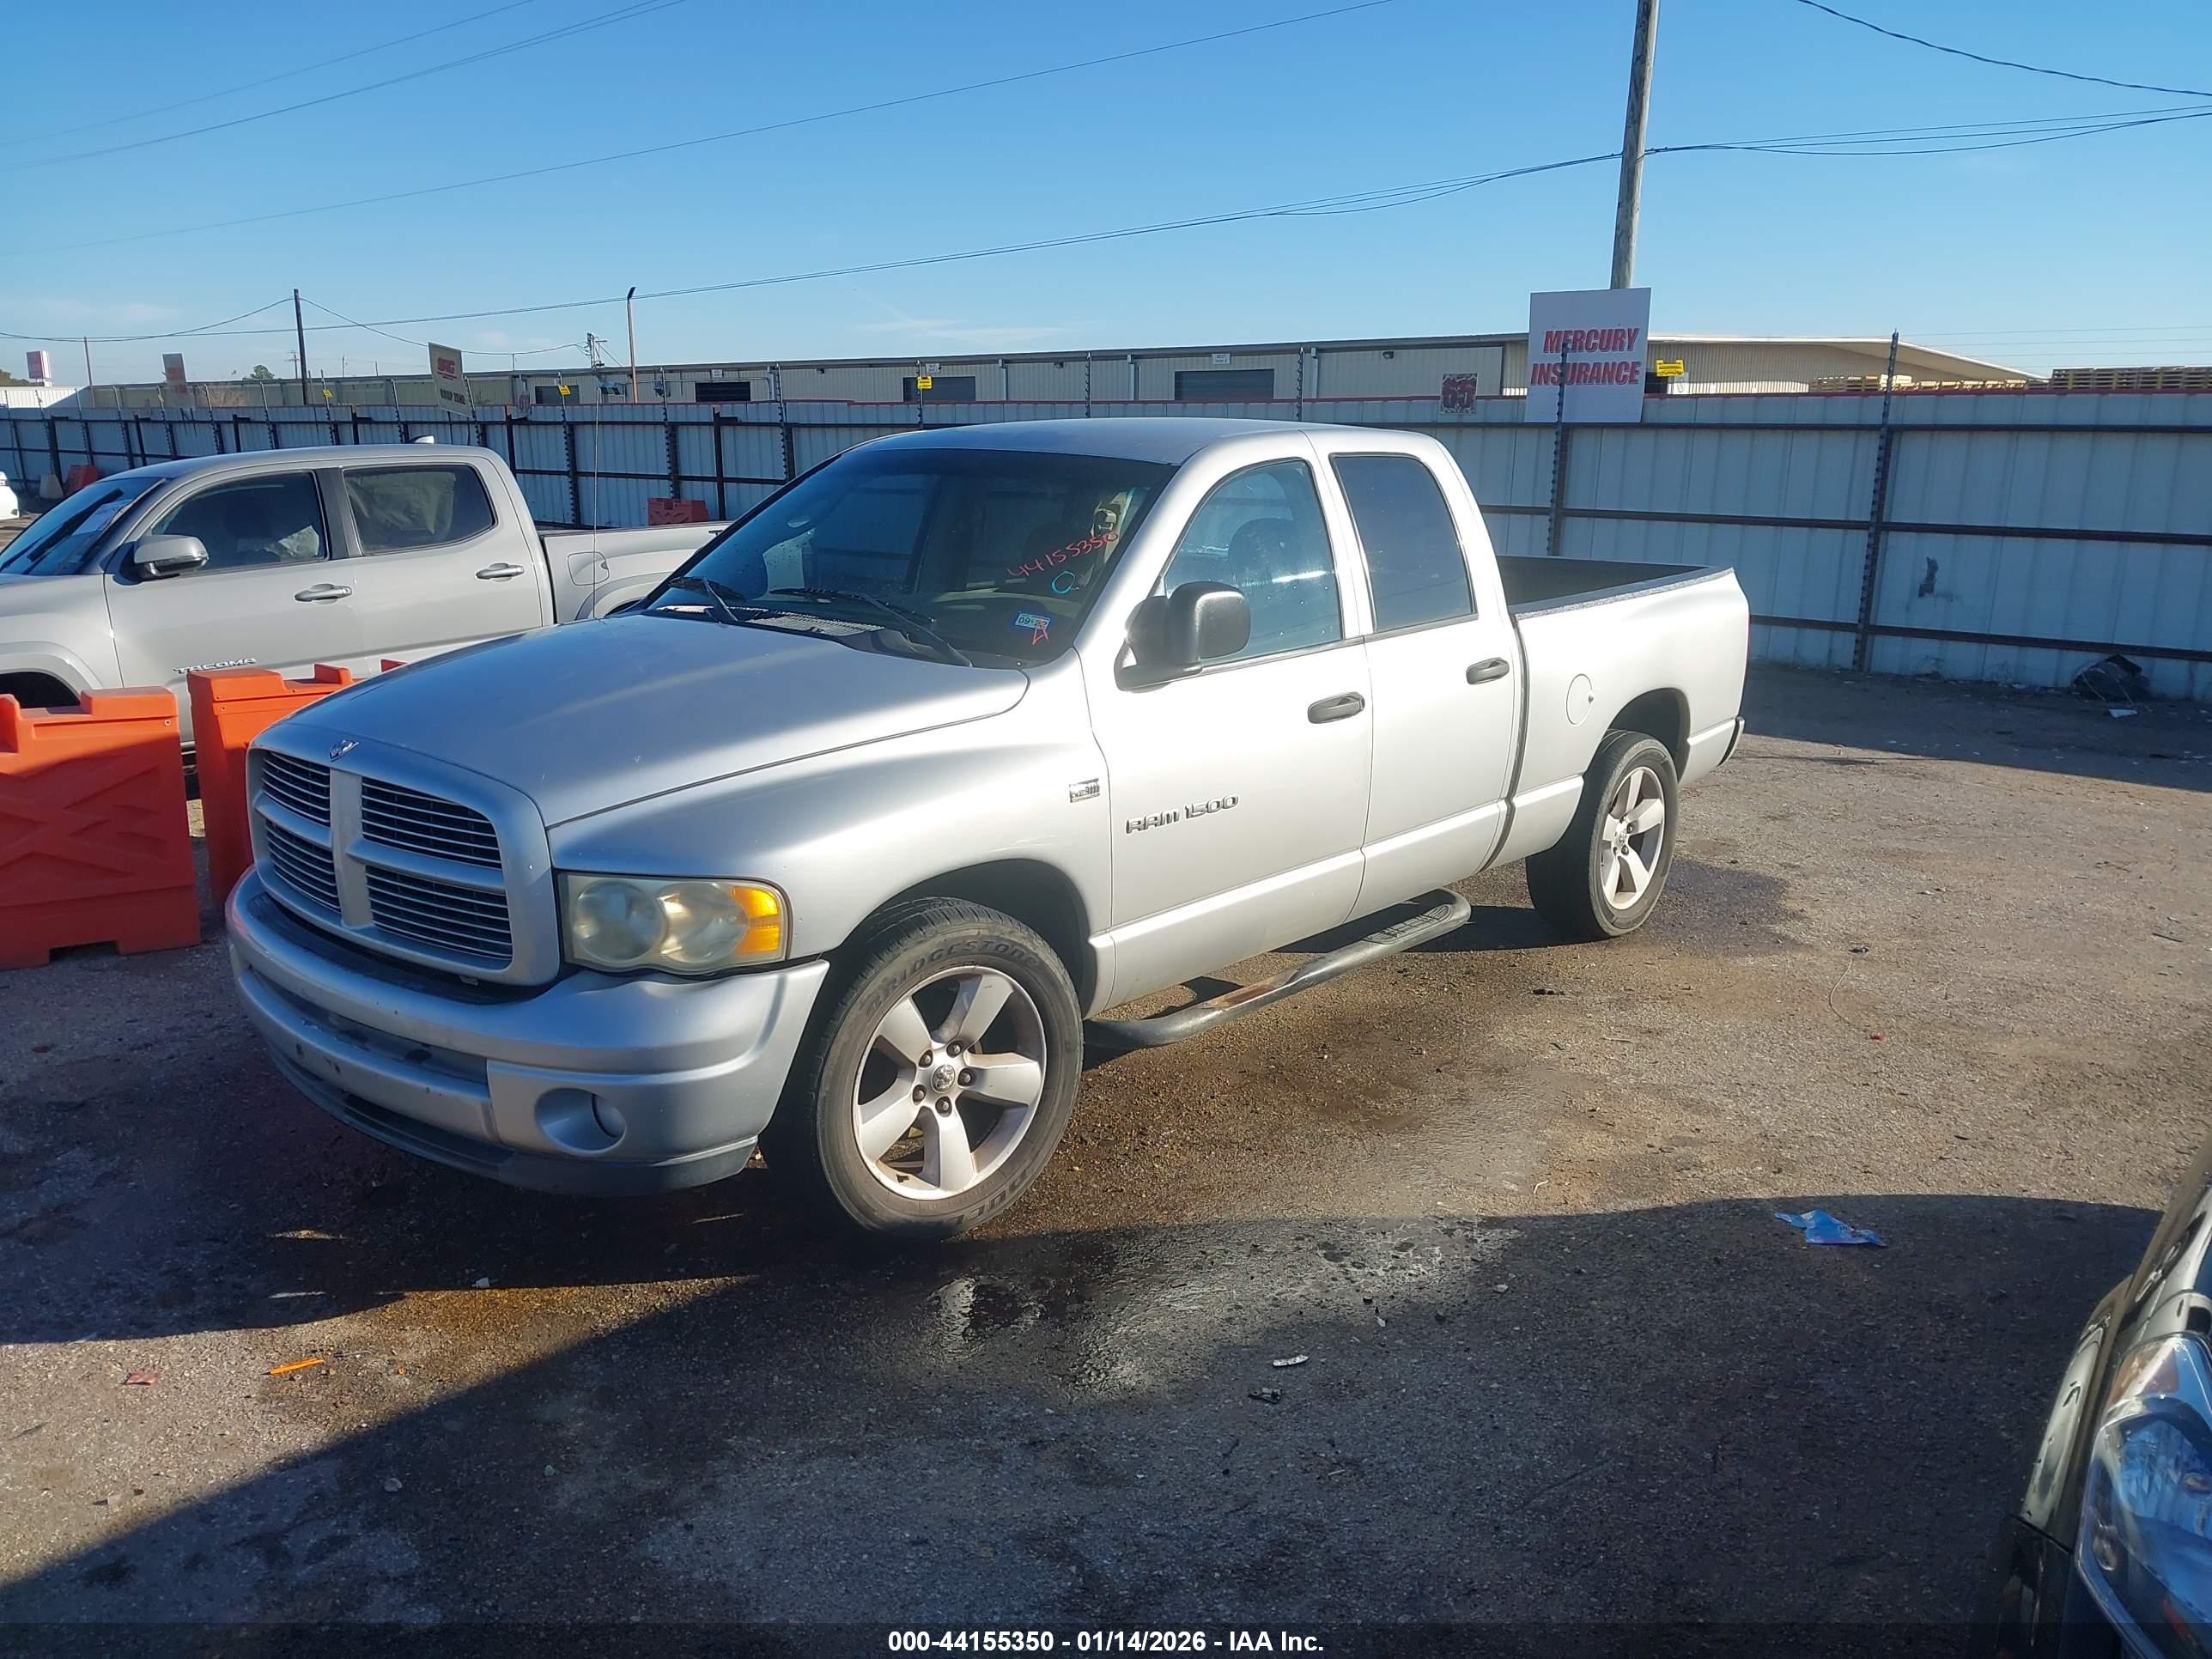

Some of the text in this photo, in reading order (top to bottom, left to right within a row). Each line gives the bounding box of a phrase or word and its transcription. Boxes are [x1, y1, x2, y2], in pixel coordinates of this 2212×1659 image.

[1543, 328, 1640, 354] MERCURY
[1531, 361, 1642, 386] INSURANCE
[1006, 531, 1119, 577] 44155350
[173, 658, 257, 674] TACOMA
[1126, 794, 1239, 834] RAM 1500
